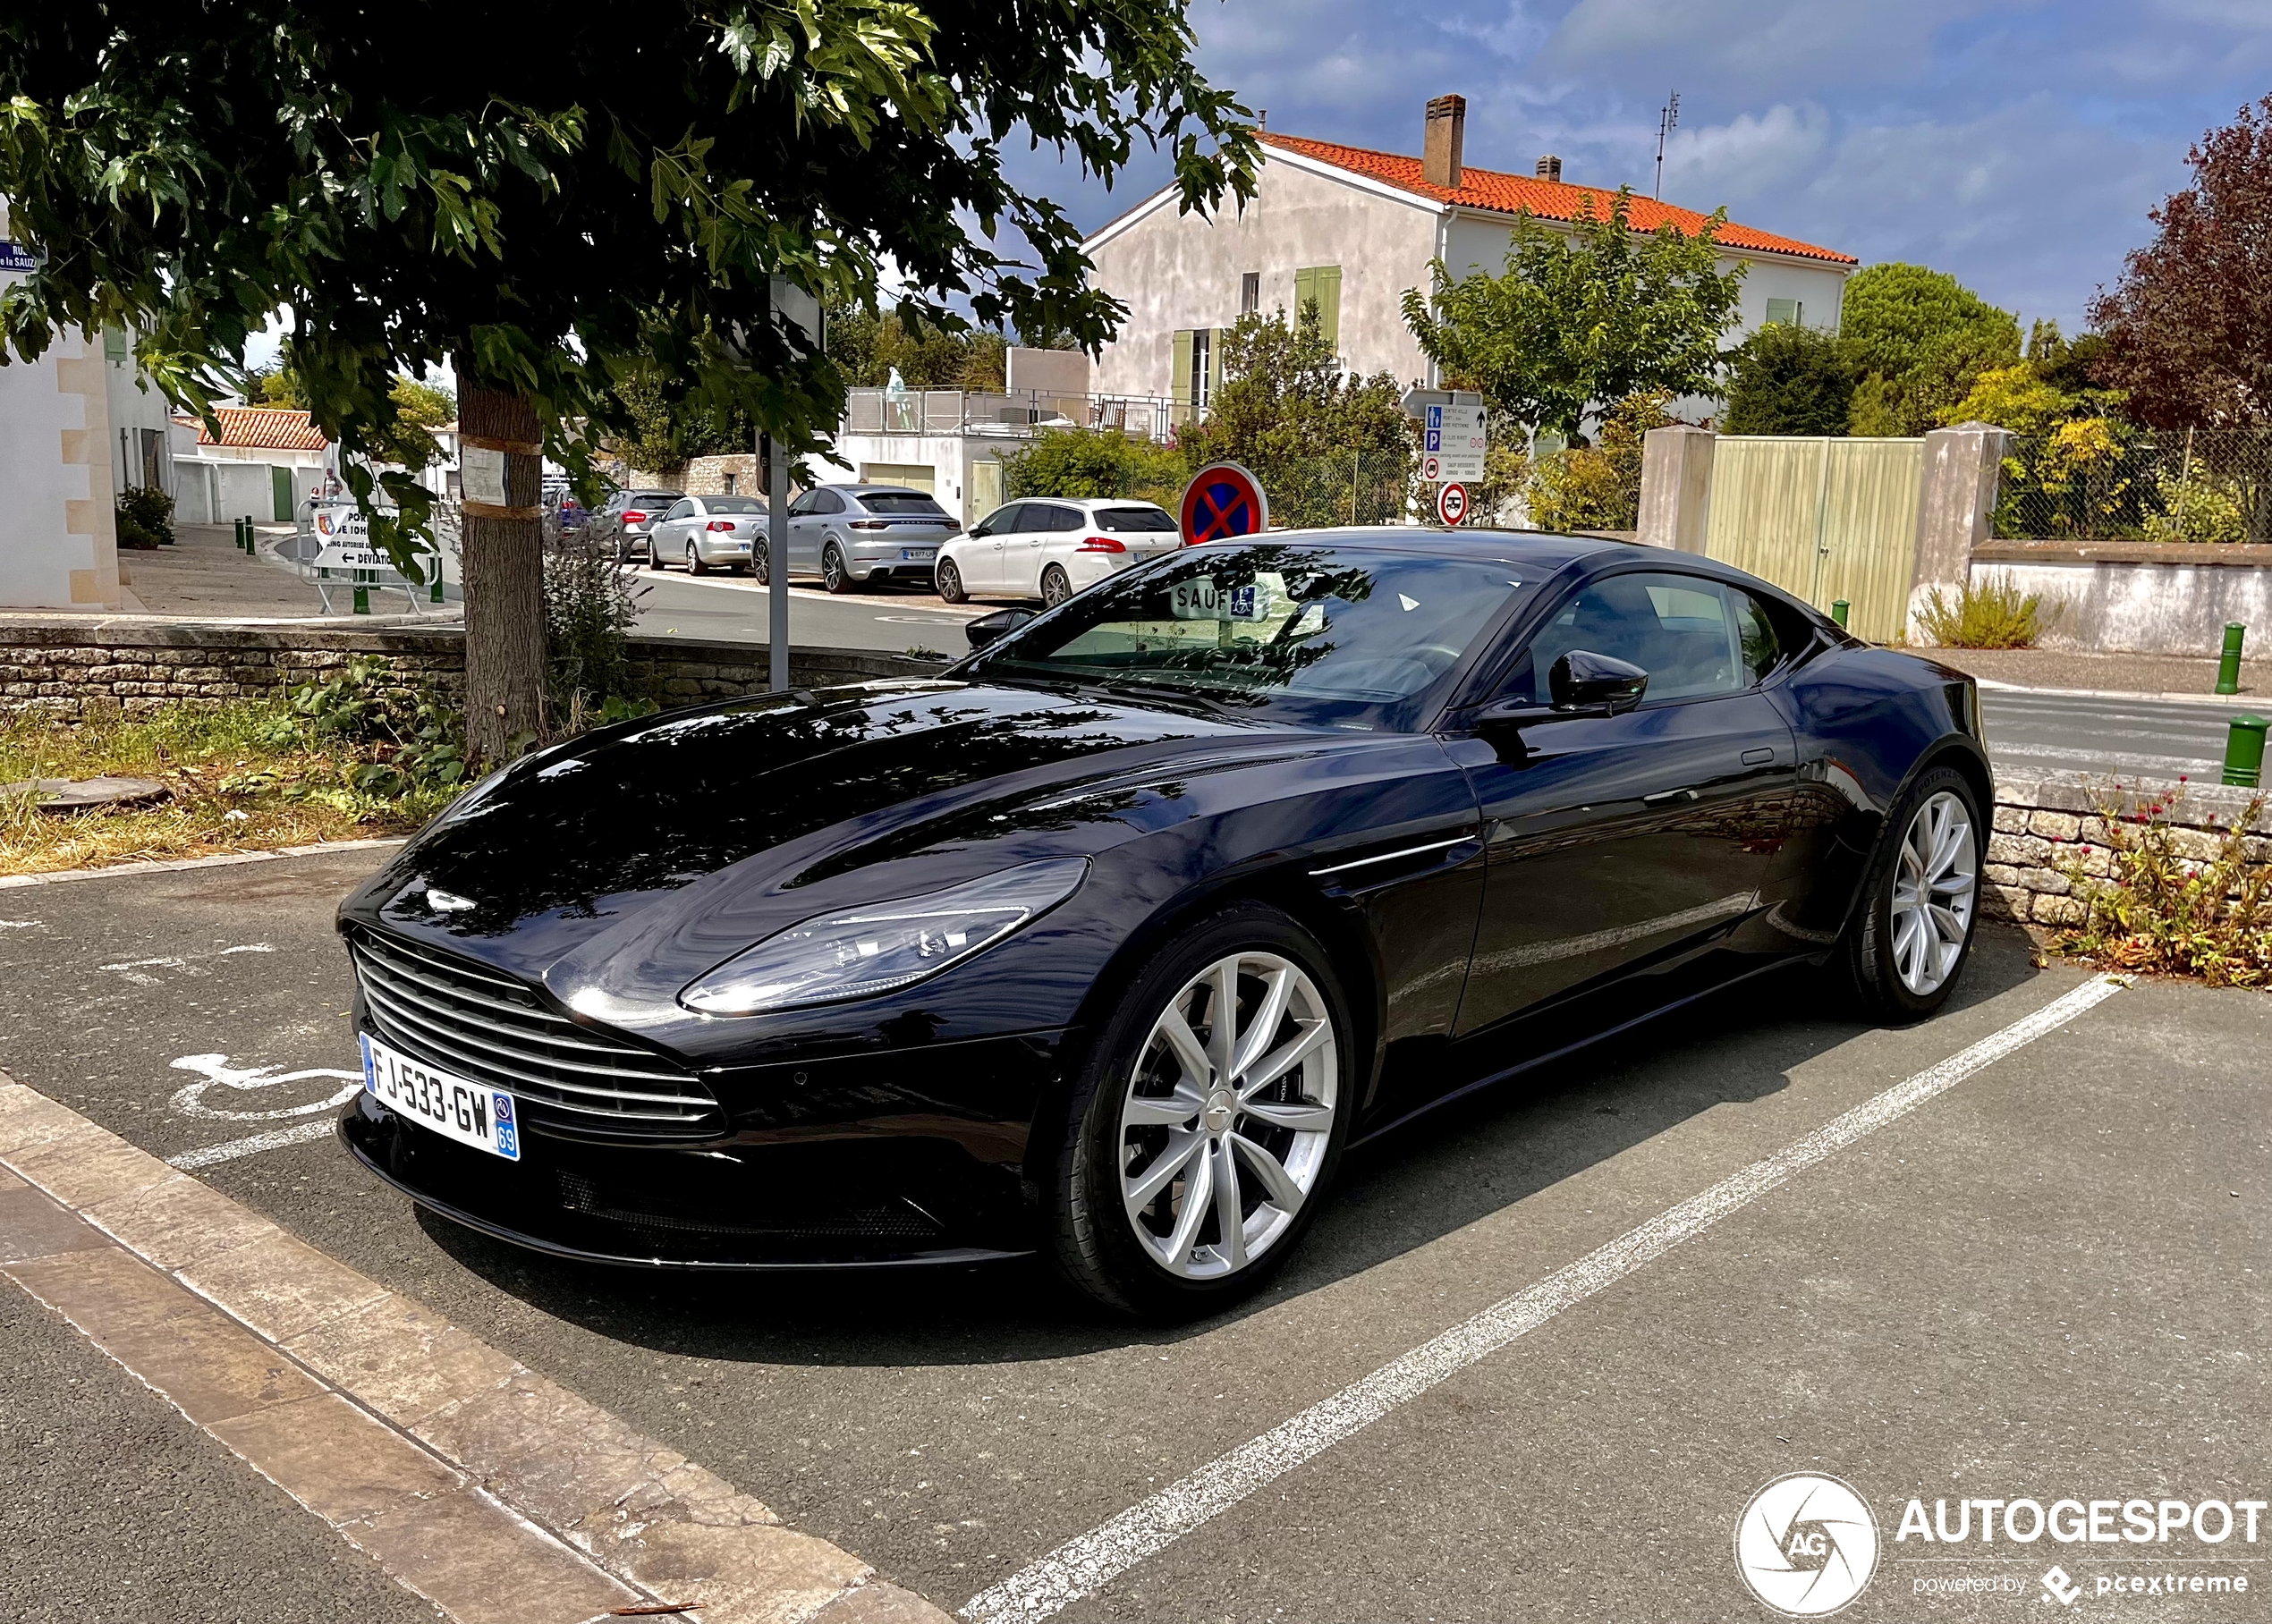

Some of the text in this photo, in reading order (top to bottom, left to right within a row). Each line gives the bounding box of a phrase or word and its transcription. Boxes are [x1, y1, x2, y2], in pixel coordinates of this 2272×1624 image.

[5, 256, 13, 266] la
[14, 257, 37, 268] SAUZ
[348, 512, 369, 522] POR
[1177, 587, 1228, 611] SAUF
[372, 1046, 488, 1138] FJ-533-GW
[497, 1126, 515, 1152] 69
